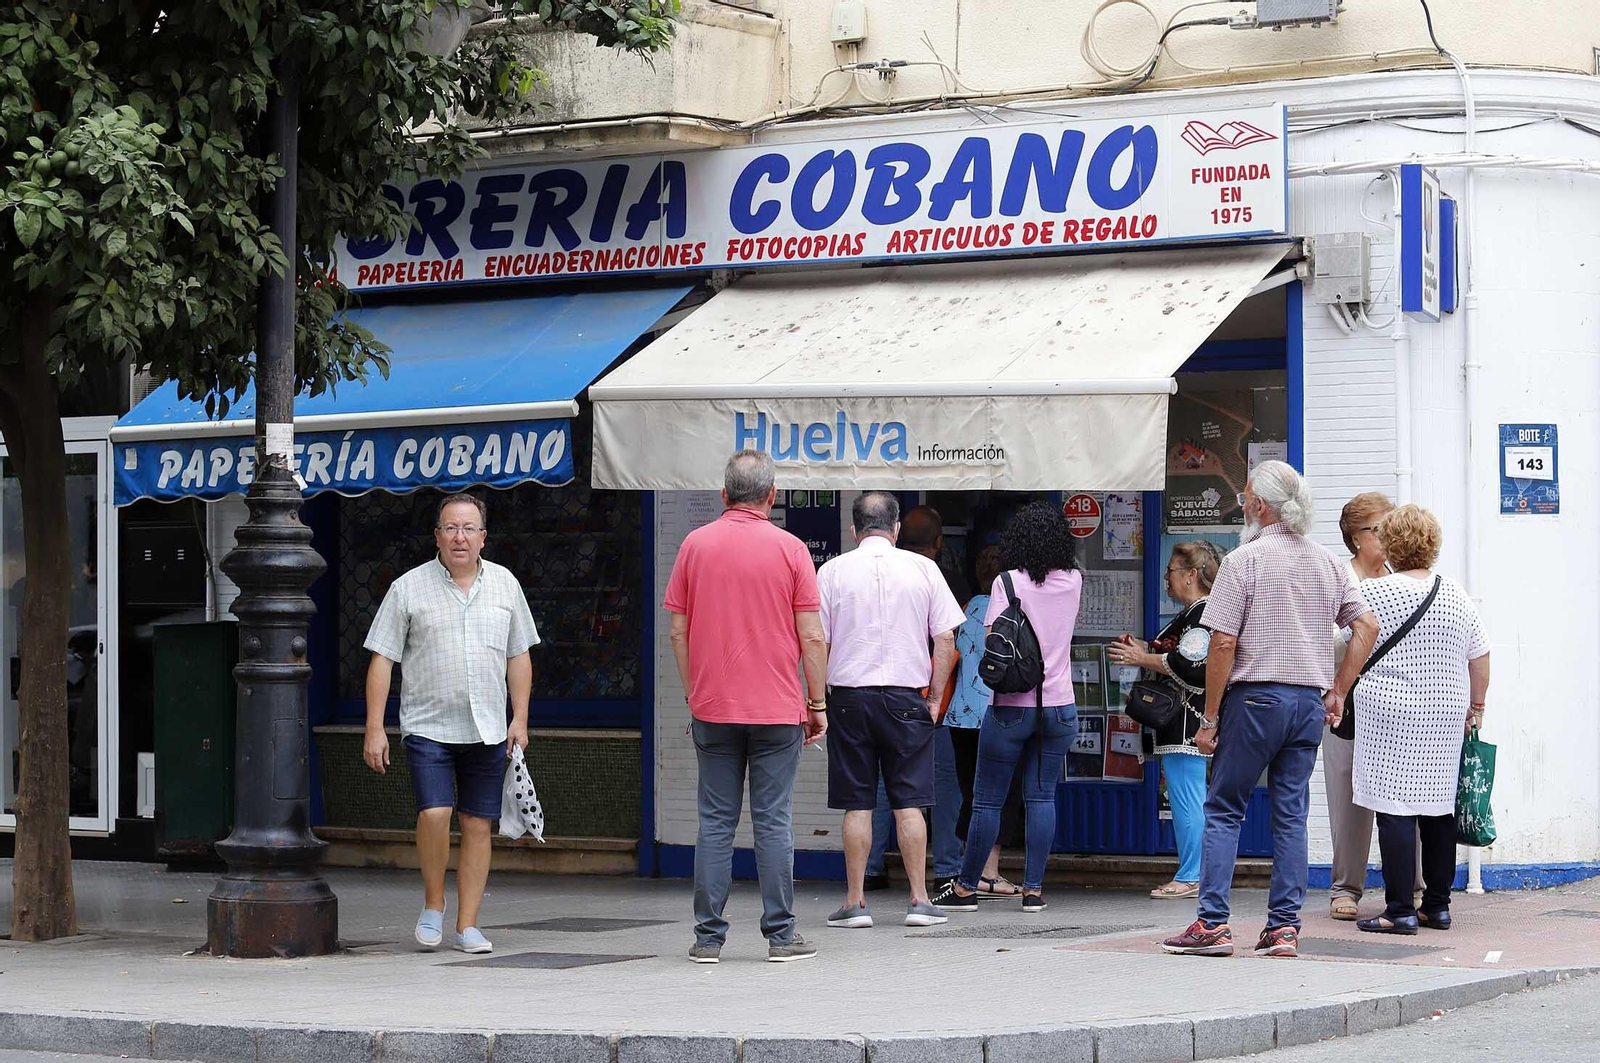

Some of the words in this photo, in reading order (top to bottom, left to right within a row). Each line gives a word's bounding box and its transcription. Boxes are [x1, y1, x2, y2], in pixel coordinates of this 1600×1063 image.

[729, 124, 1159, 234] COBANO
[1191, 163, 1271, 183] FUNDADA
[1219, 186, 1242, 203] EN
[1210, 206, 1253, 225] 1975
[357, 259, 464, 286] PAPELERIA
[484, 242, 706, 278] ENCUADERNACIONES
[727, 231, 866, 261] FOTOCOPIAS
[886, 223, 1013, 254] ARTICULOS
[1021, 220, 1054, 245] DE
[1061, 214, 1159, 243] REGALO
[735, 410, 909, 463] Huelva
[917, 442, 1005, 462] Información
[1518, 429, 1540, 442] BOTE
[393, 429, 566, 479] COBANO
[1517, 458, 1544, 471] 143
[1070, 498, 1091, 512] +18
[1174, 501, 1215, 509] JUEVES
[1170, 508, 1221, 518] SÁBADOS
[805, 538, 820, 548] rías
[1075, 649, 1090, 659] BOTE
[1119, 720, 1134, 730] BOTE
[1076, 740, 1095, 749] 143
